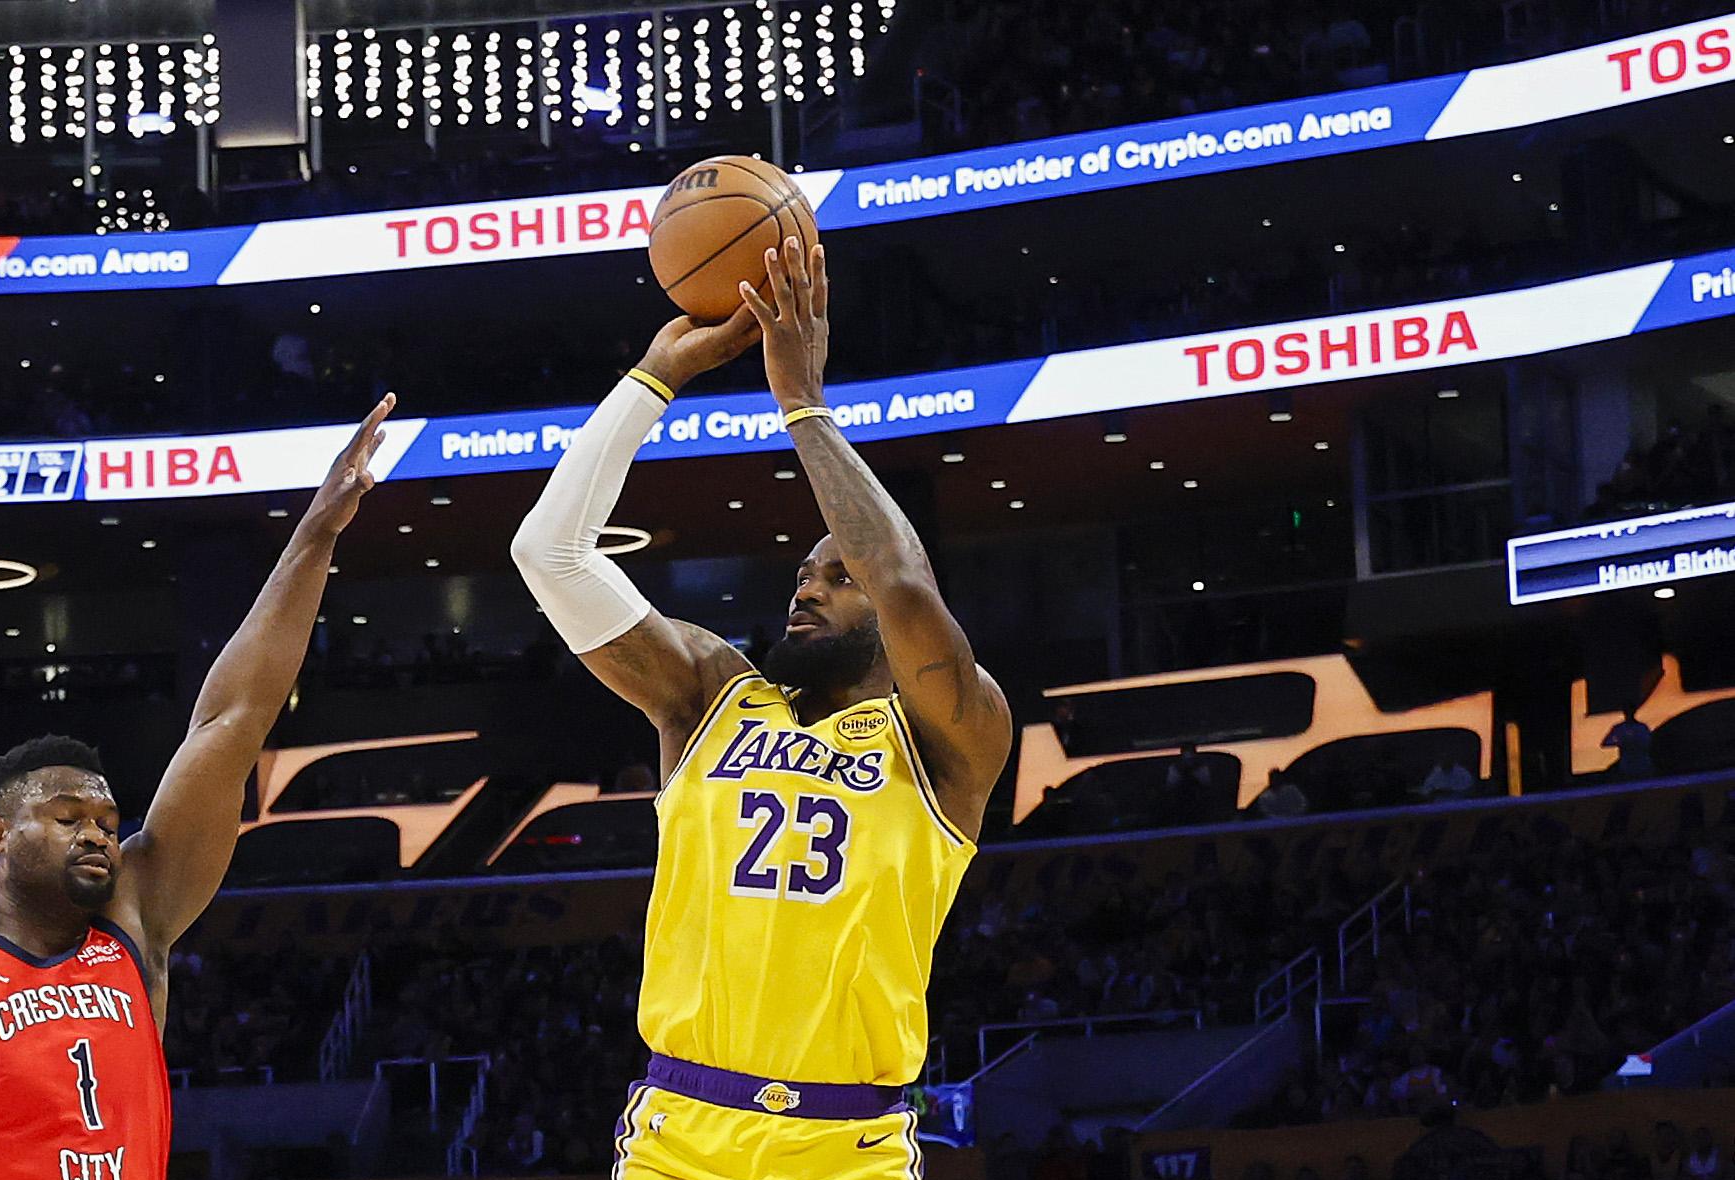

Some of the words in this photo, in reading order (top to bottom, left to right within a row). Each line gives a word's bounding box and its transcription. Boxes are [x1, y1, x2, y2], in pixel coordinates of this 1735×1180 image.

[858, 172, 950, 208] Printer
[955, 149, 1075, 194] Provider
[1080, 145, 1111, 174] of
[1115, 122, 1292, 169] Crypto.com
[1298, 106, 1392, 142] Arena
[101, 249, 188, 274] Arena
[386, 200, 651, 257] TOSHIBA
[1691, 267, 1735, 302] Pri
[1184, 309, 1479, 387] TOSHIBA
[442, 426, 537, 461] Printer
[669, 413, 701, 442] of
[887, 388, 975, 422] Arena
[39, 467, 62, 497] 7
[83, 446, 242, 489] HIBA
[704, 718, 887, 793] LAKERS
[728, 788, 852, 904] 23
[68, 1038, 104, 1130] 1
